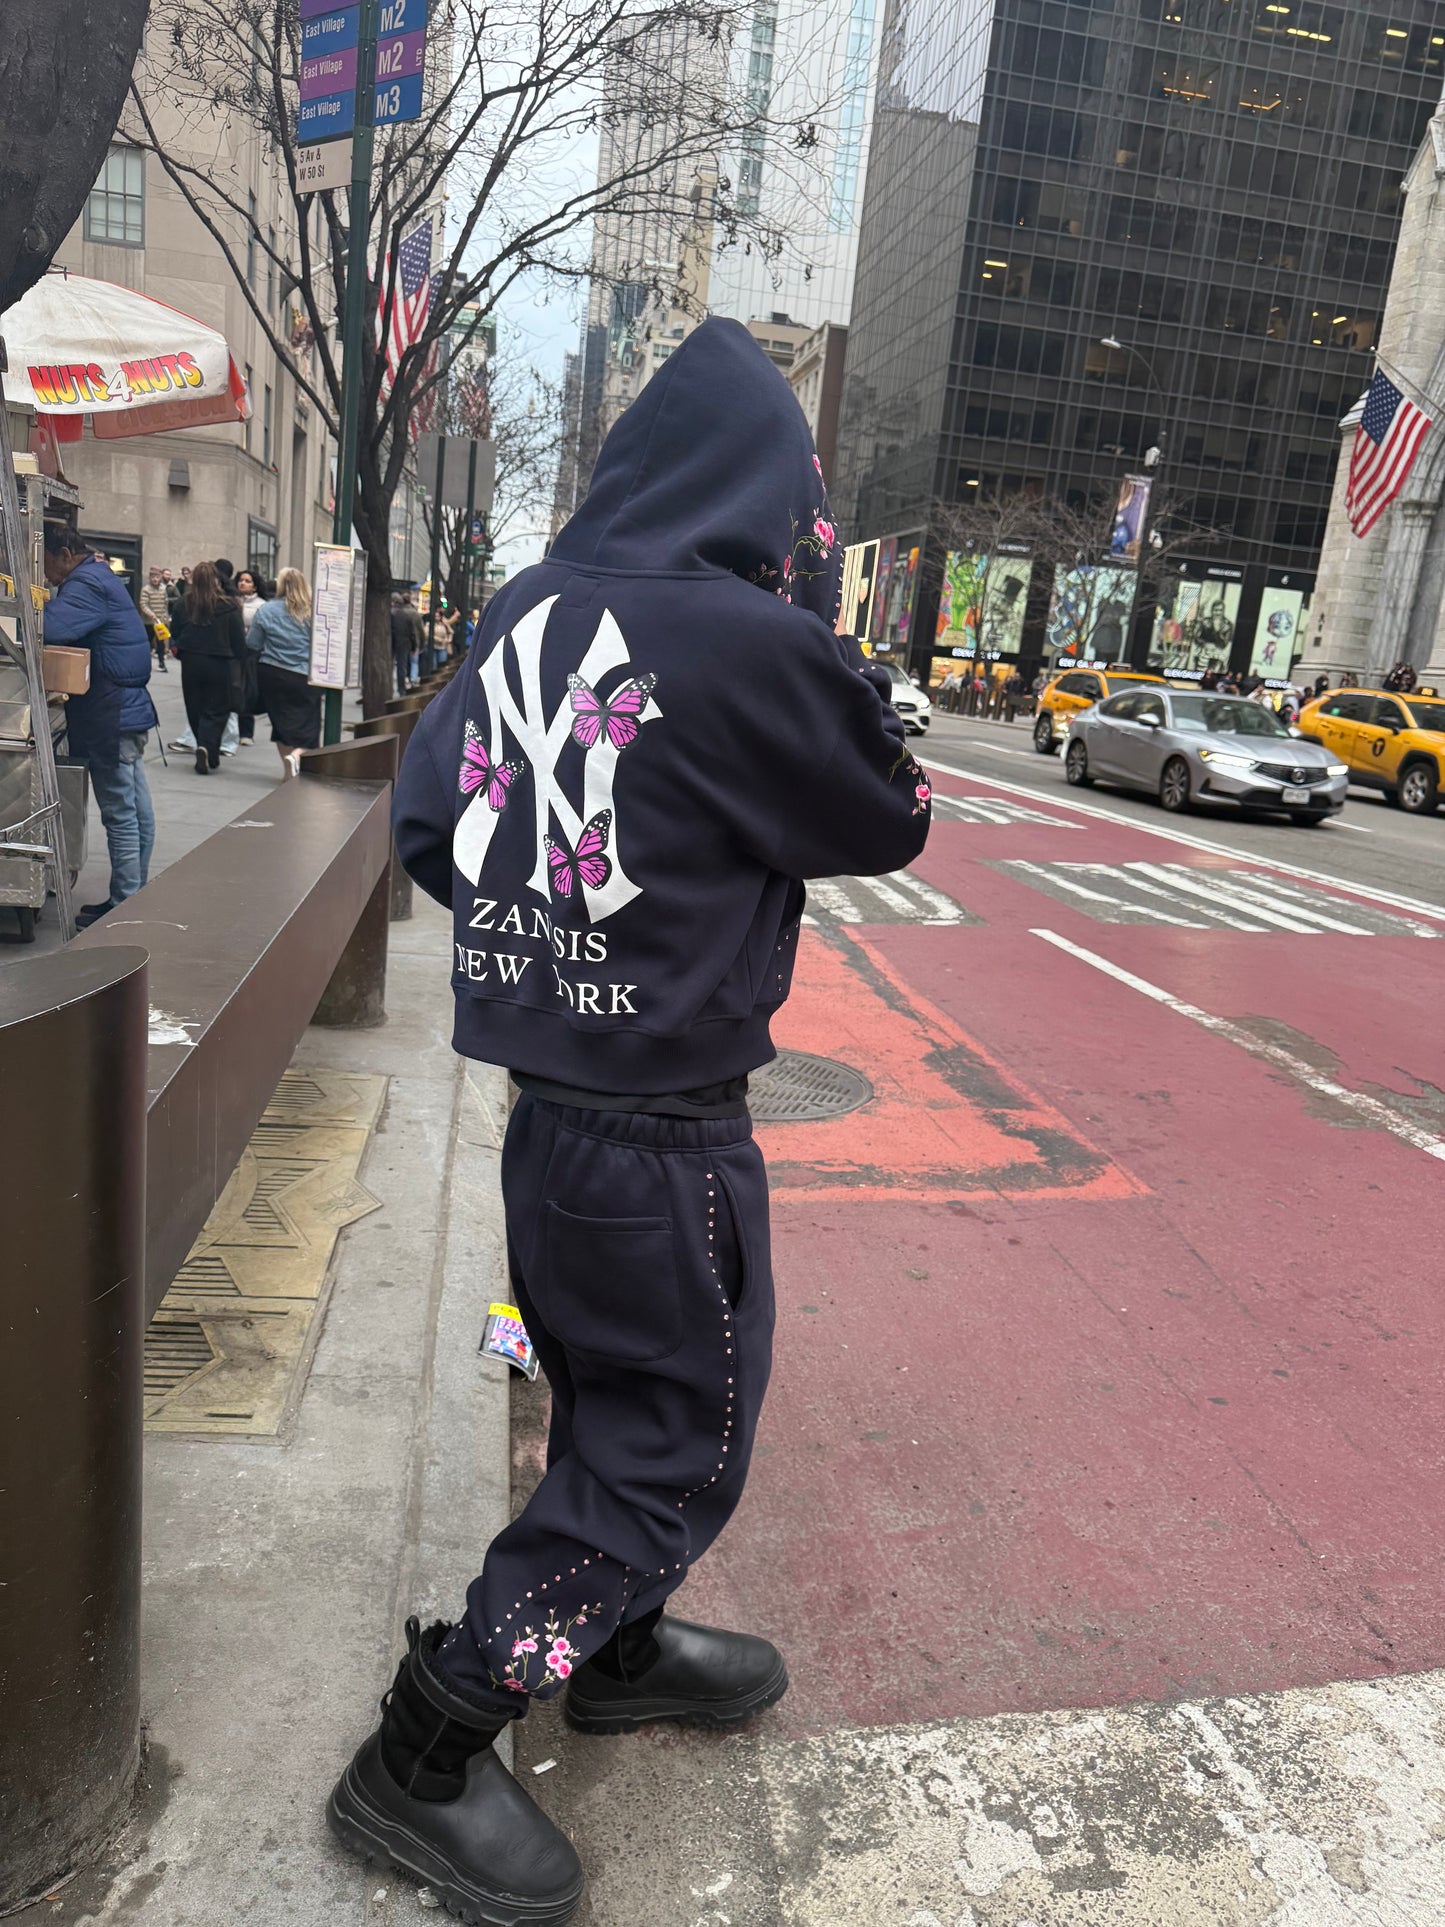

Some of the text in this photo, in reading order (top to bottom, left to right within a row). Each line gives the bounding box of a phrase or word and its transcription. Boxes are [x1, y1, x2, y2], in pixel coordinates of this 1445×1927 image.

[380, 0, 406, 33] M2
[306, 17, 345, 38] East Village
[378, 41, 423, 75] M2 LTD
[304, 59, 343, 79] East Village
[302, 100, 340, 120] East Village
[376, 85, 401, 118] M3
[300, 148, 321, 164] 5 Av &
[300, 164, 325, 181] W 50 St
[455, 942, 534, 985] NEW
